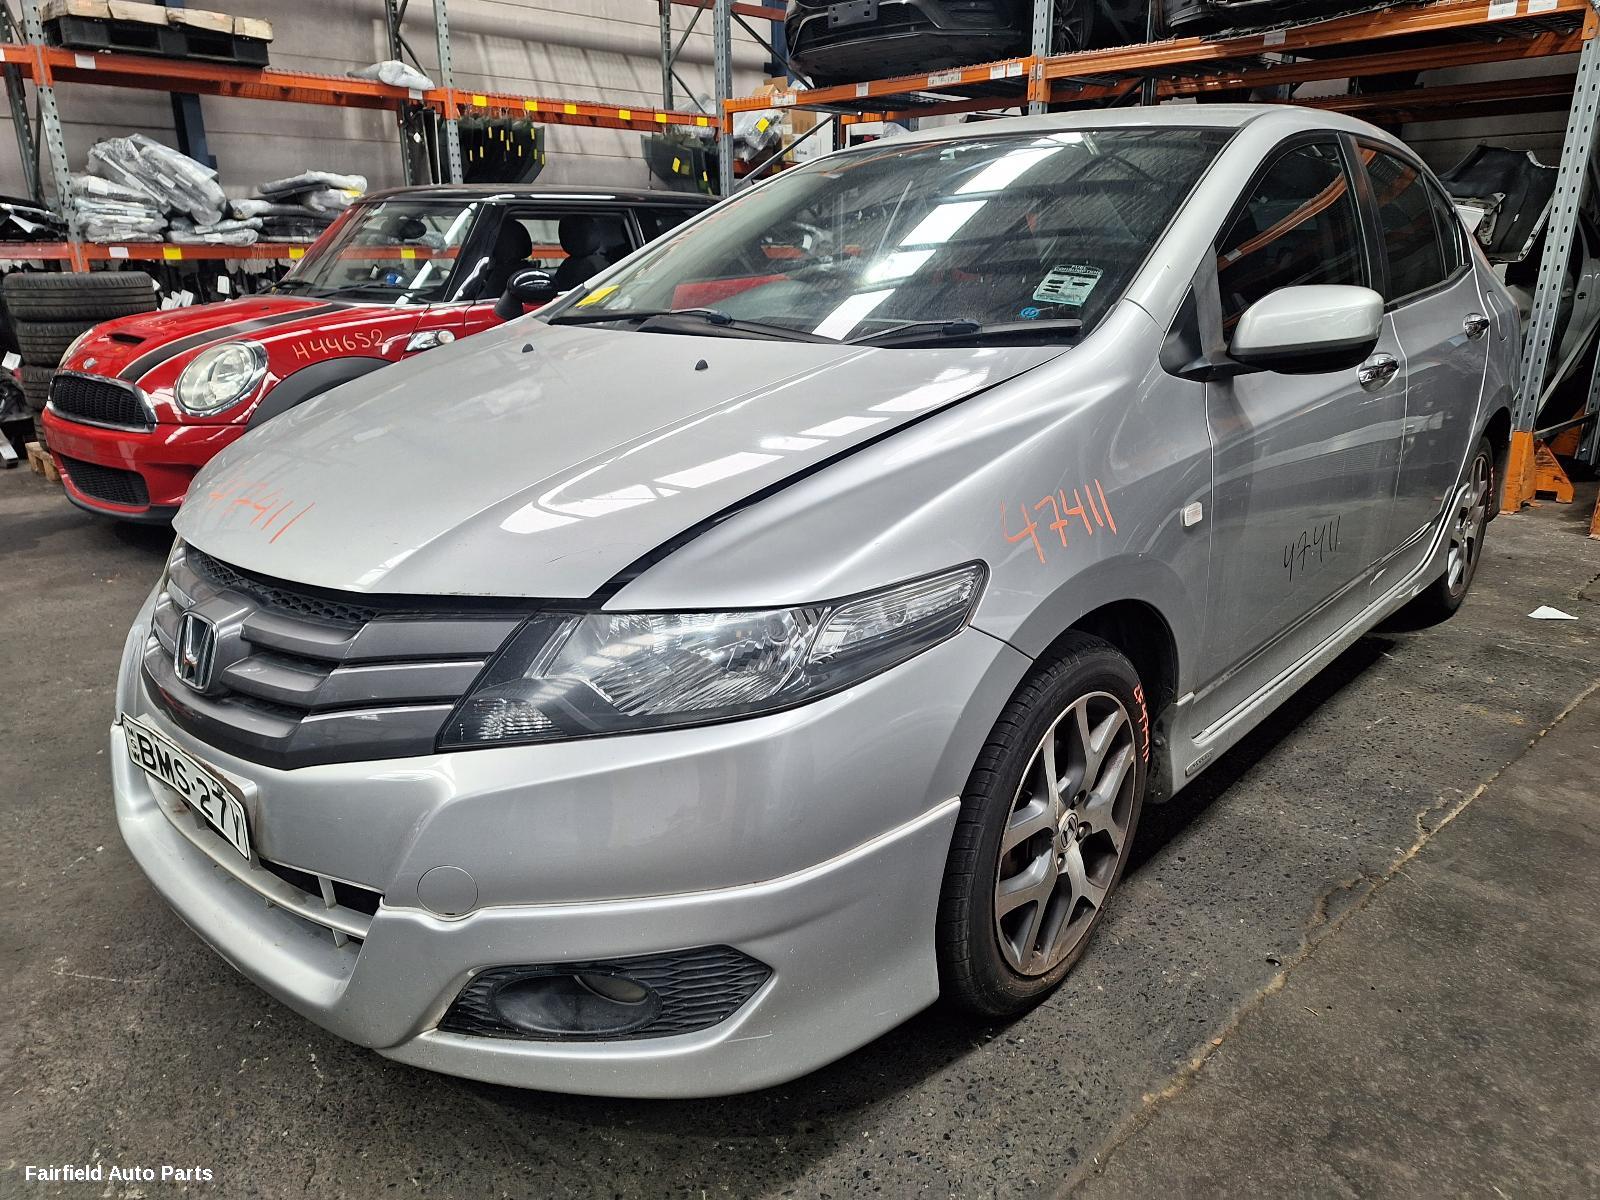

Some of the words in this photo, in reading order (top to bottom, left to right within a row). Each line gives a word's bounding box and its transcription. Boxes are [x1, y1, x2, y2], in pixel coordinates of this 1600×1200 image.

[291, 328, 384, 360] H44652
[999, 478, 1118, 564] 47411
[1283, 514, 1341, 583] 47411
